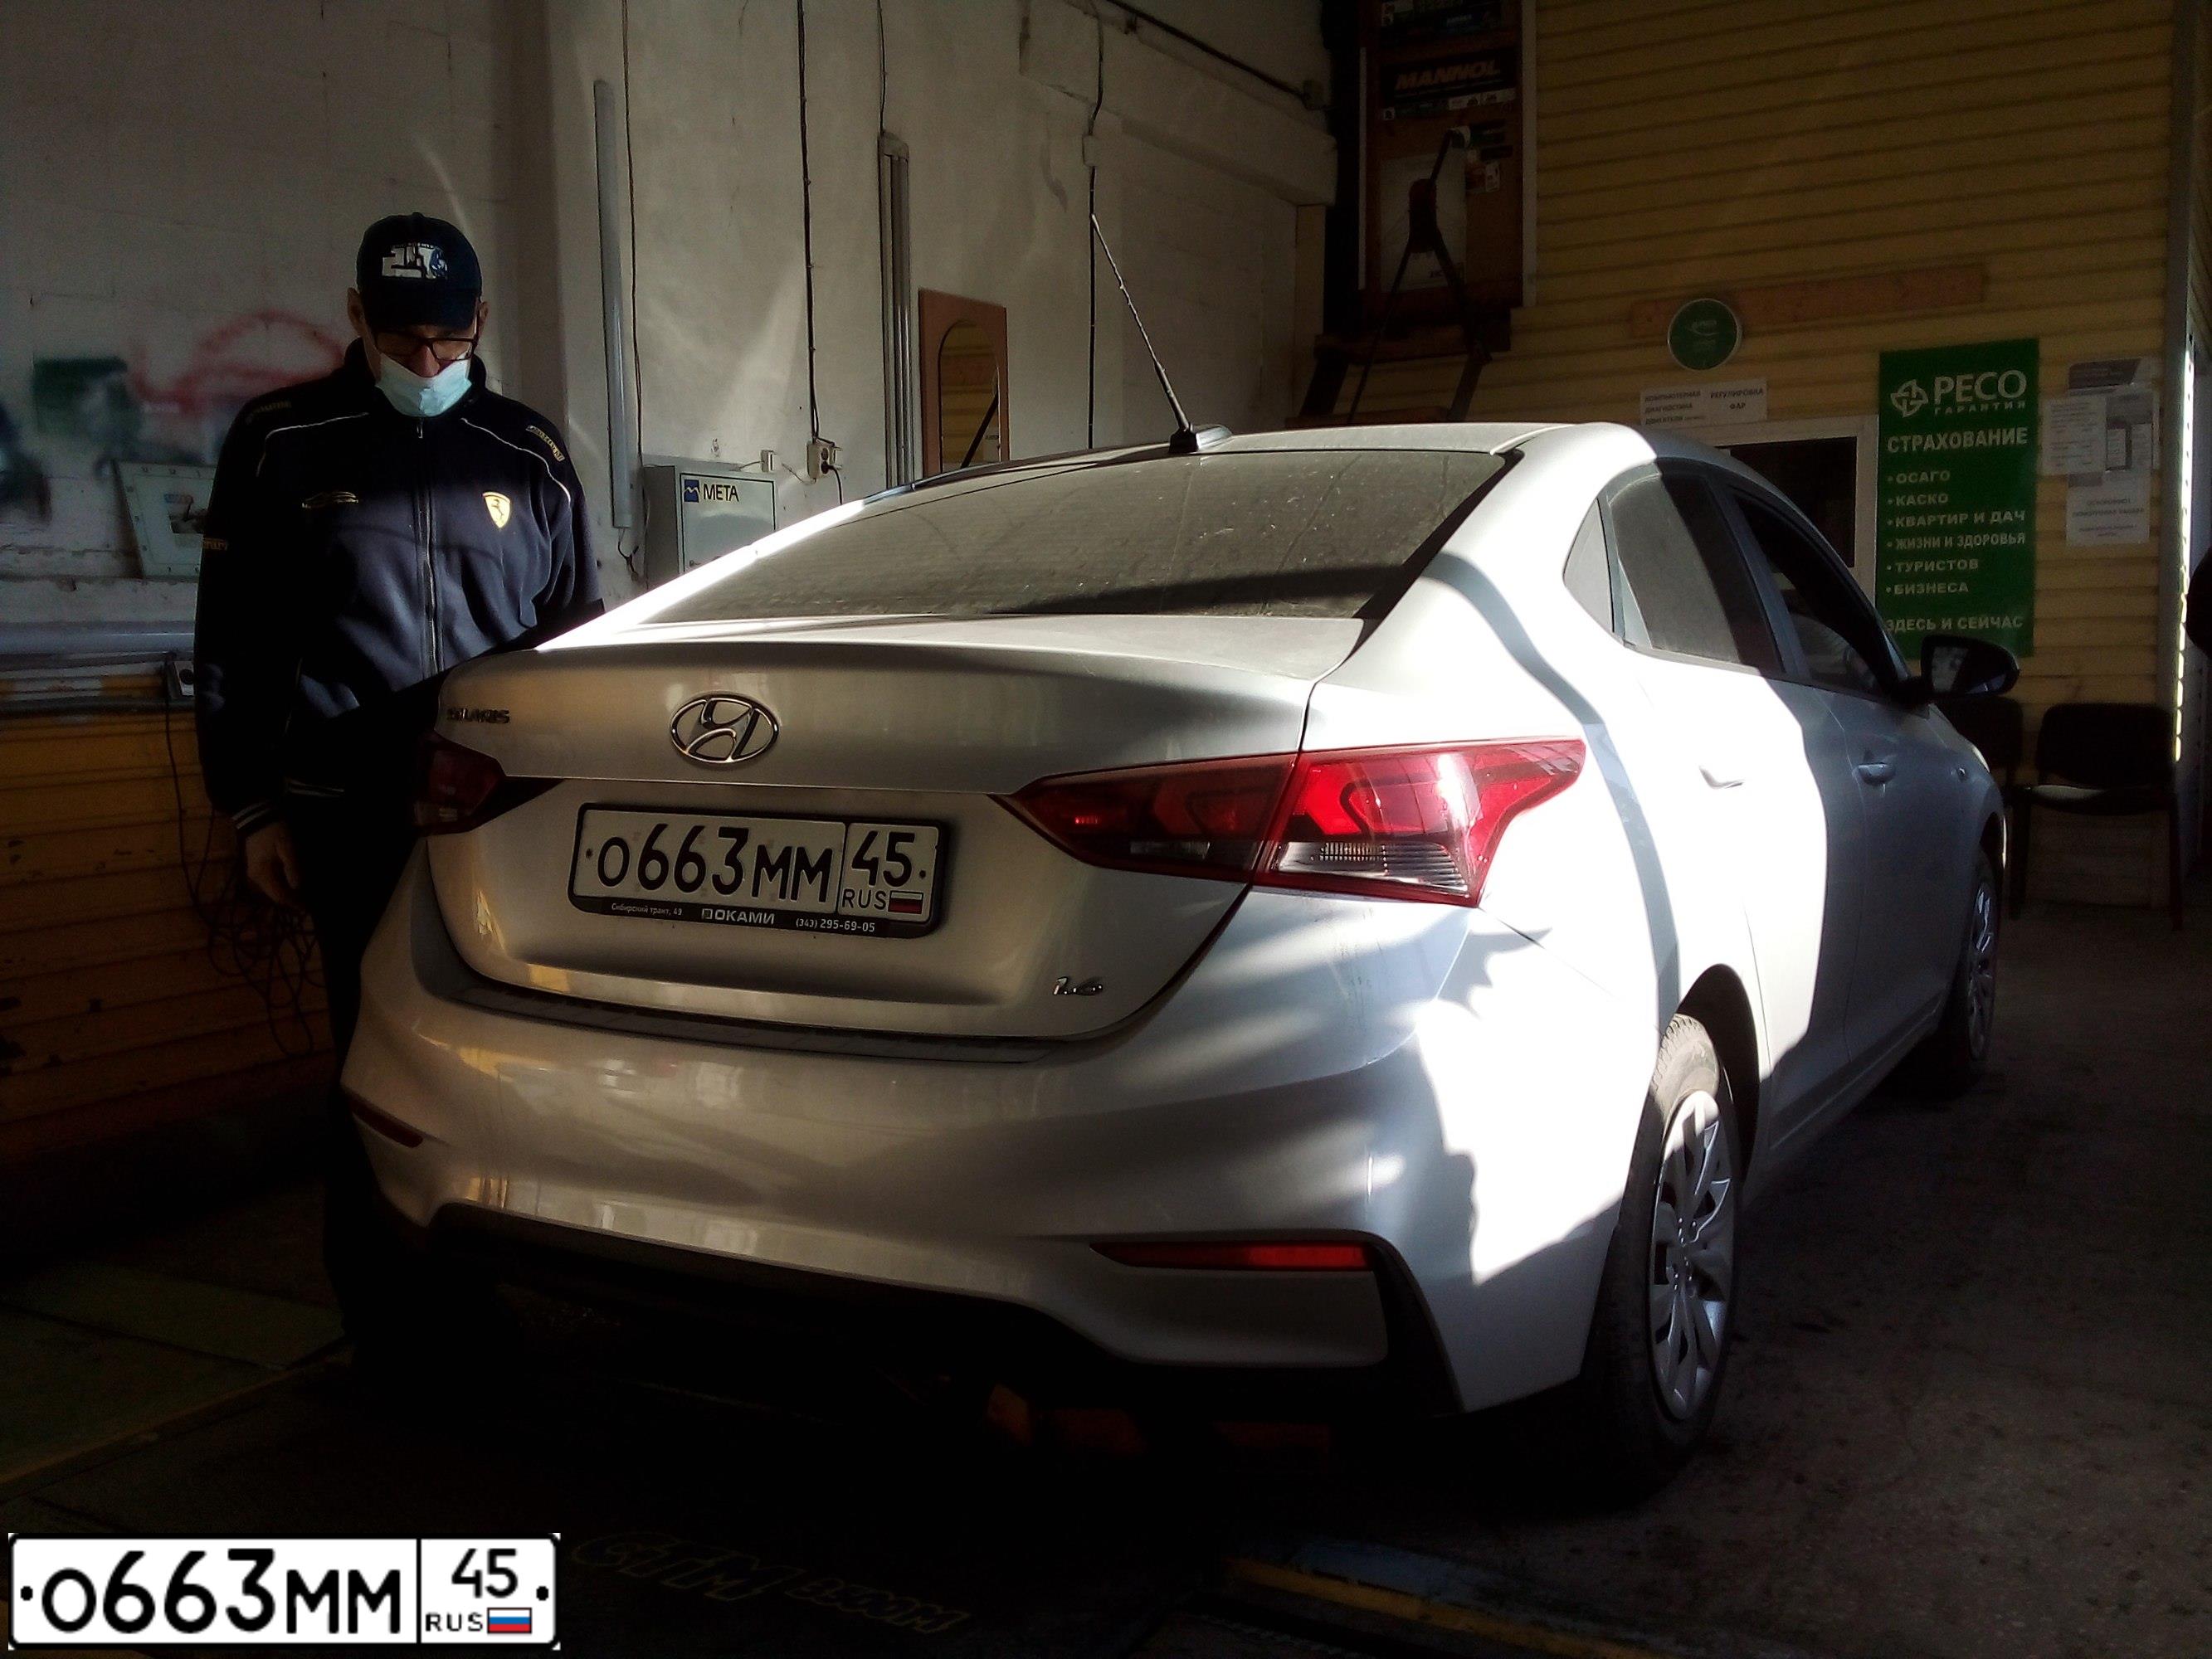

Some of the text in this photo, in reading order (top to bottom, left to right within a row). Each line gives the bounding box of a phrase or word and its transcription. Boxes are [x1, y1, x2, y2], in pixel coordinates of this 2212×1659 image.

[1934, 369, 2028, 405] РЕСО
[1935, 401, 2025, 416] ГАРАНТИЯ
[1887, 426, 2028, 453] СТРАХОВАНИЕ
[1896, 469, 1951, 484] ОСАГО
[1896, 493, 1949, 506] КАСКО
[1896, 510, 2025, 528] КВАРТИР И ДАЧ
[1896, 533, 2026, 550] ЖИЗНИ И ЗДОРОВЬЯ
[1895, 558, 1979, 572] ТУРИСТОВ
[1893, 581, 1969, 595] БИЗНЕСА
[1887, 615, 2024, 633] ЗДЕСЬ И СЕЙЧАС
[597, 823, 915, 904] О663ММ 45
[842, 888, 887, 911] RUS
[796, 917, 818, 930] (343)
[819, 918, 876, 932] 295-69-05
